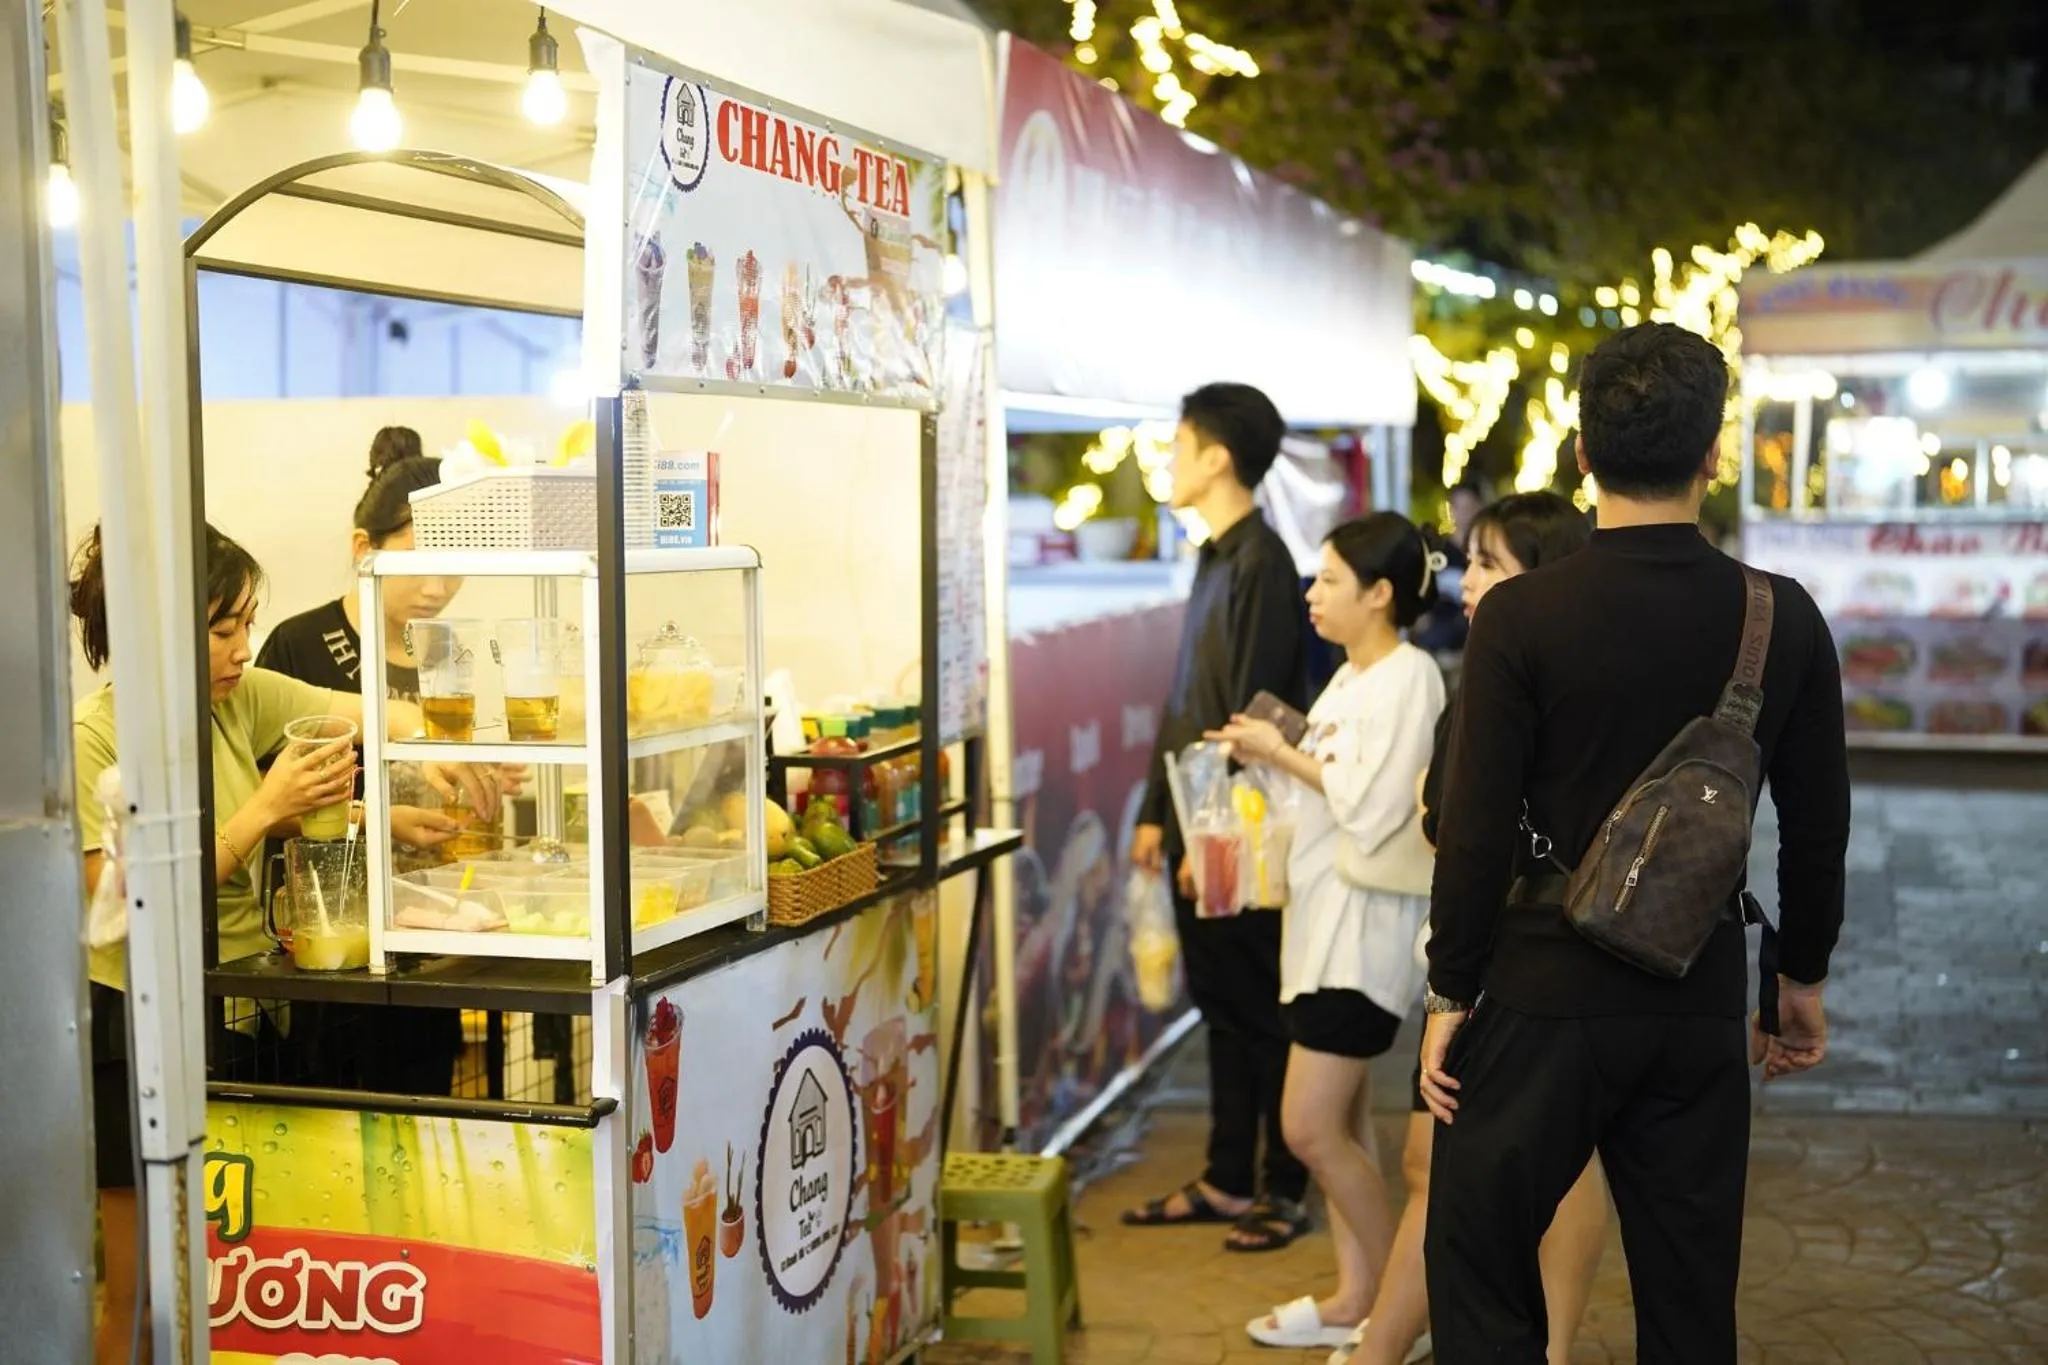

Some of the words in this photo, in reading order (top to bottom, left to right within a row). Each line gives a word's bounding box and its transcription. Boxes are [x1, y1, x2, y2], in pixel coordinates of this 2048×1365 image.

[716, 100, 843, 196] CHANG
[853, 147, 910, 217] TEA
[790, 1171, 828, 1213] Chang
[798, 1218, 813, 1240] Tea
